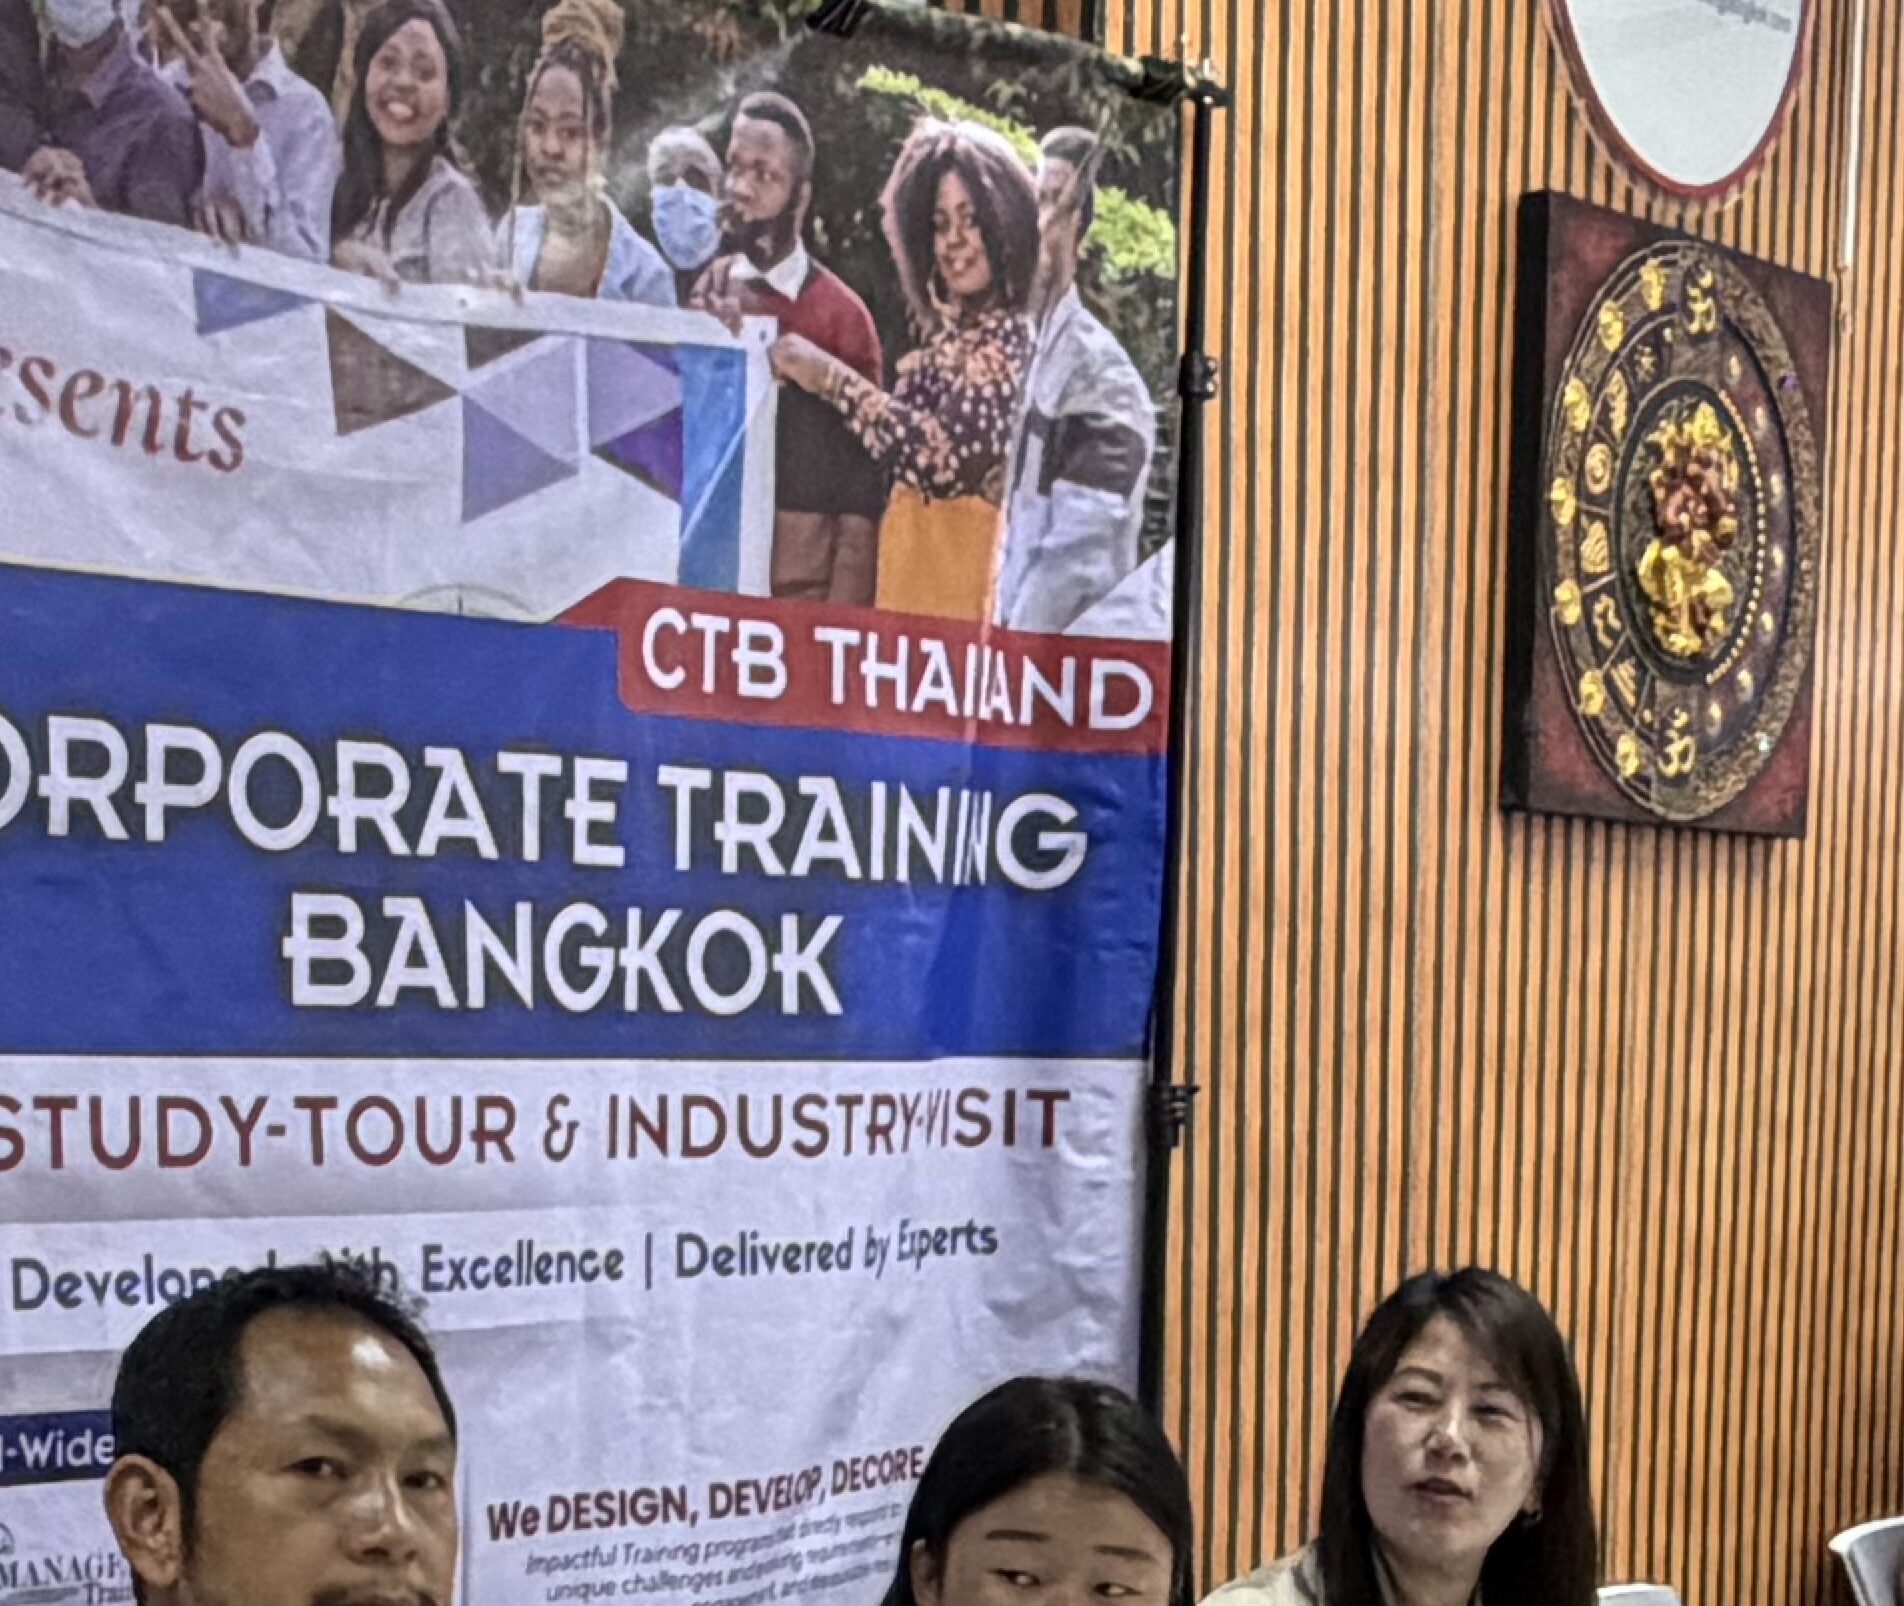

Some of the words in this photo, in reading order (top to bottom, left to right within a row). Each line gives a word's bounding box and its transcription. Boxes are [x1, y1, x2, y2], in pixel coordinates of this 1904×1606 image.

[643, 609, 788, 701] CTB
[659, 764, 1088, 890] TRAINING
[283, 892, 844, 1016] BANGKOK
[543, 1093, 580, 1162] &
[12, 1250, 277, 1310] Develop
[422, 1238, 624, 1292] Excellence
[675, 1227, 852, 1279] Delivered
[863, 1226, 887, 1280] by
[487, 1500, 540, 1541] We
[547, 1484, 698, 1533] DESIGN,
[708, 1465, 827, 1519] DEVELOP,
[525, 1543, 616, 1576] Impactful
[622, 1541, 698, 1567] Training
[545, 1579, 617, 1603] unique
[621, 1569, 723, 1598] challenges
